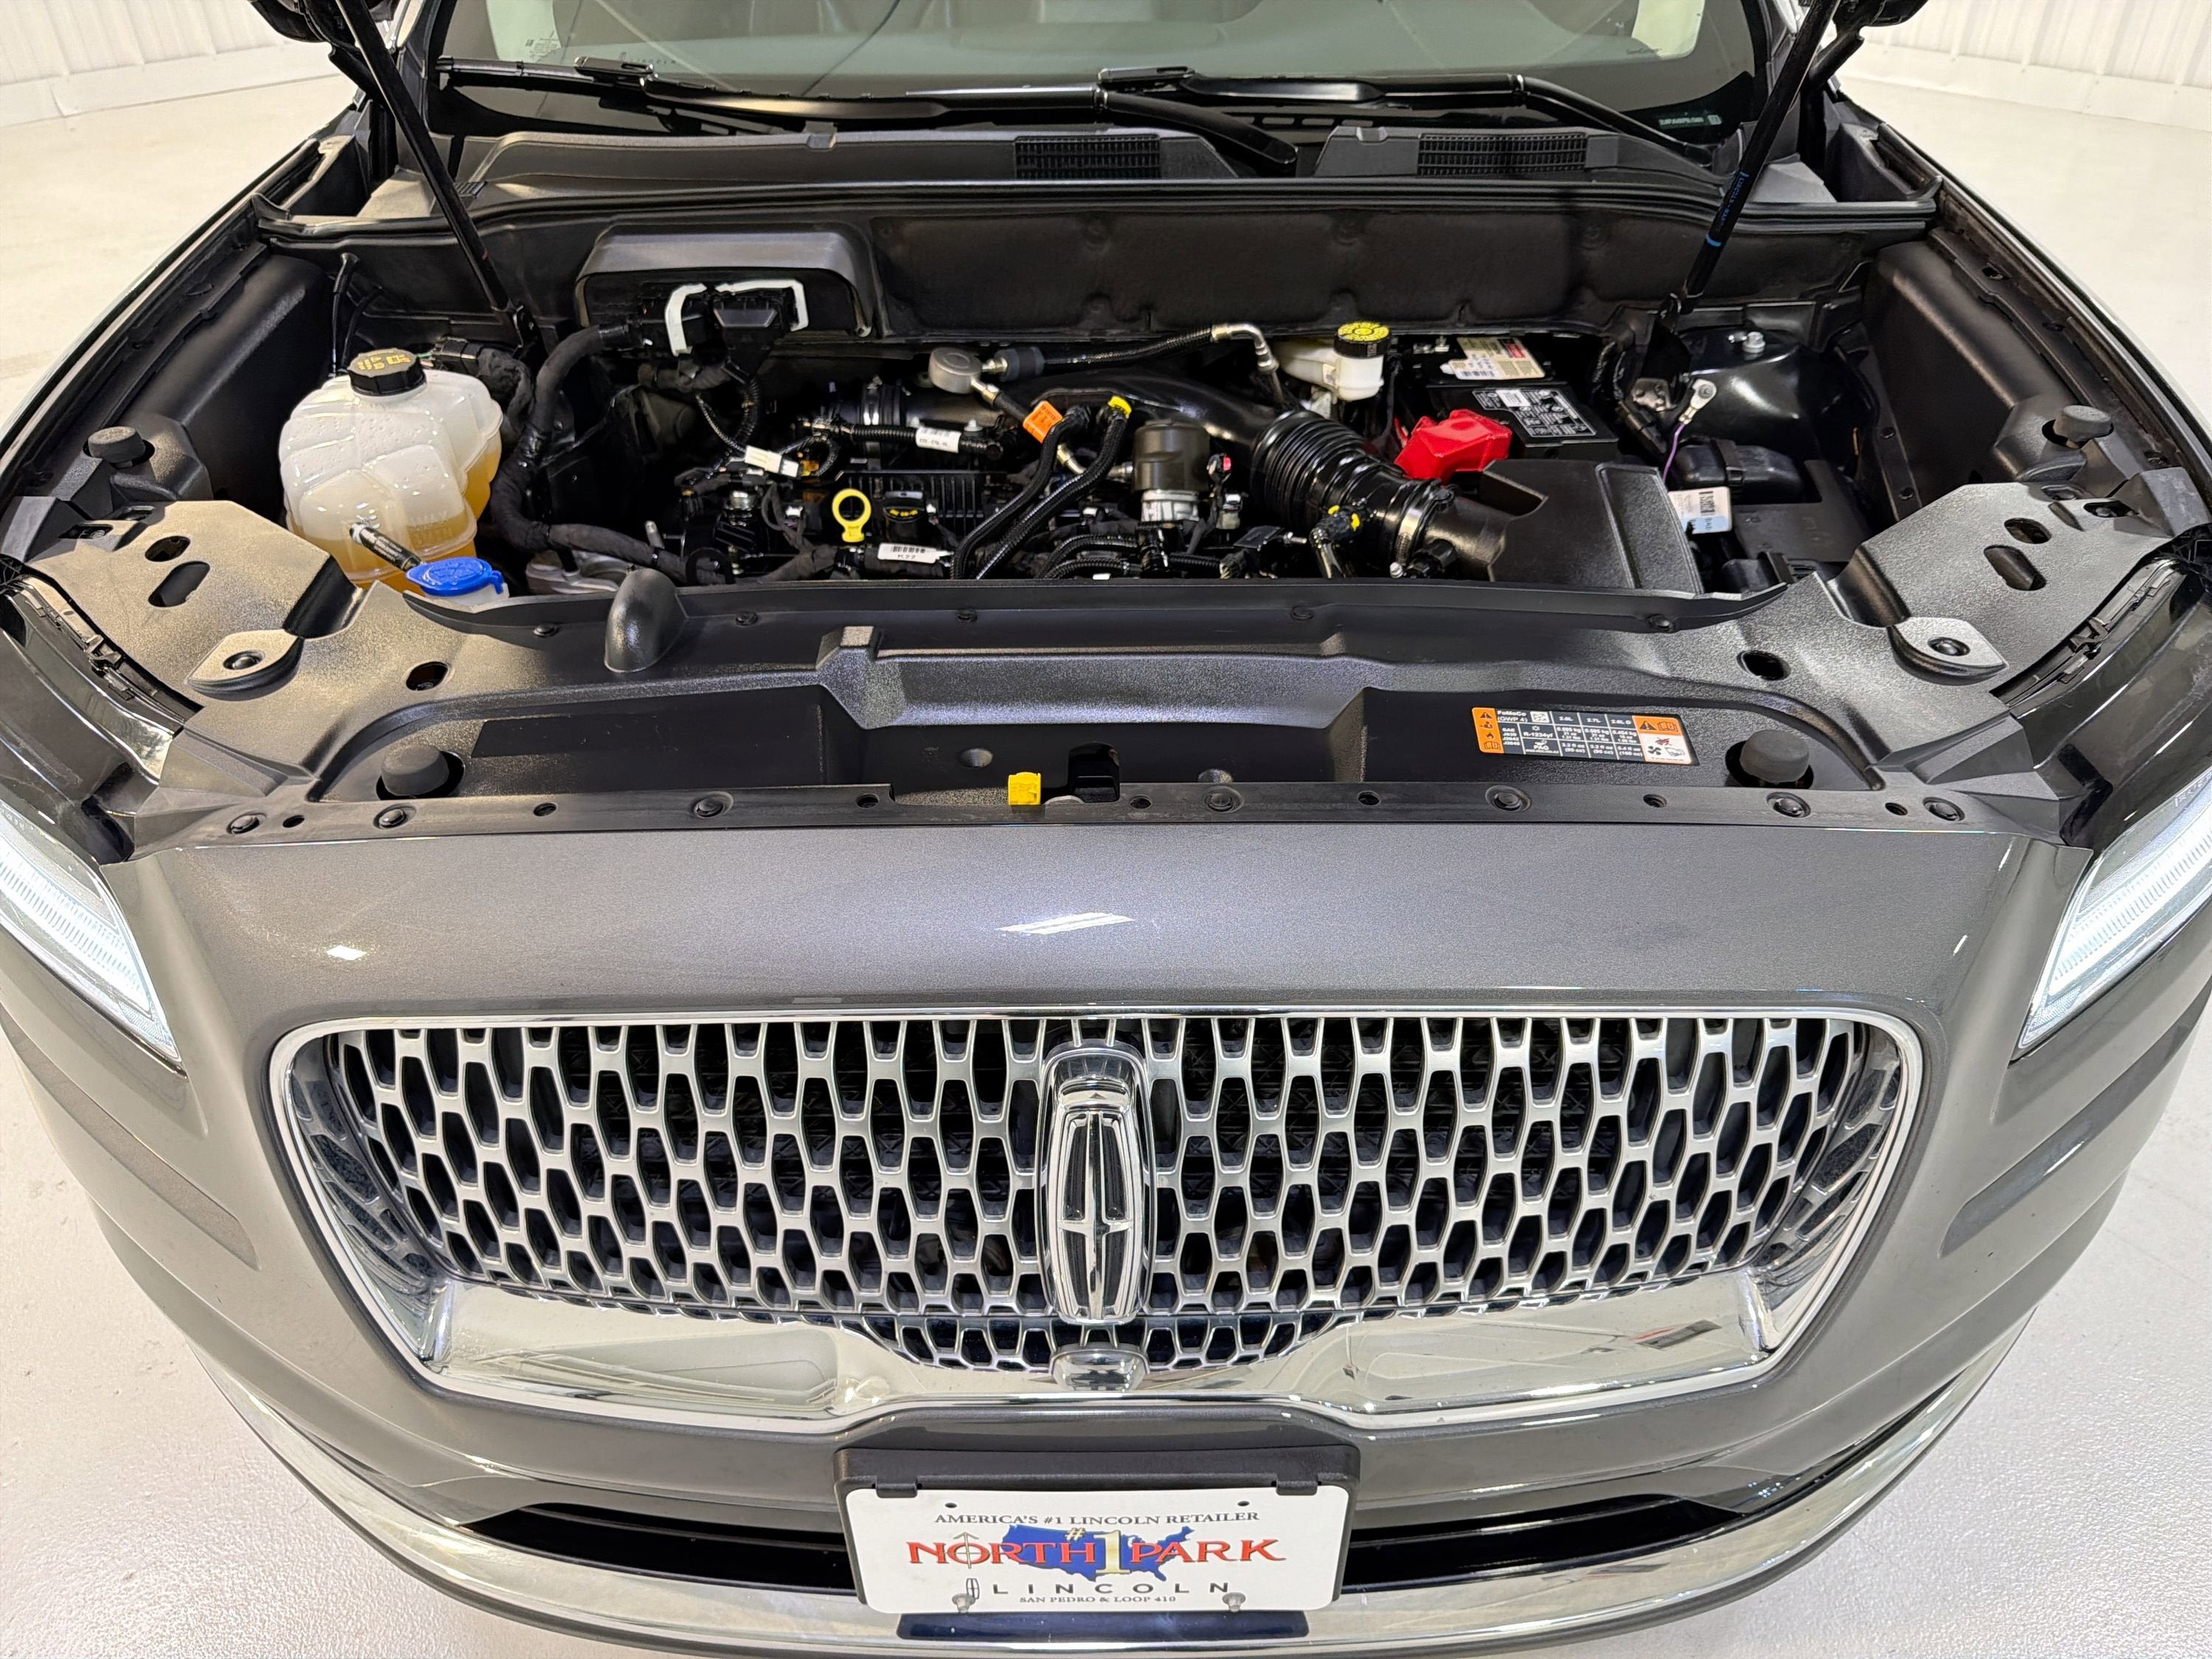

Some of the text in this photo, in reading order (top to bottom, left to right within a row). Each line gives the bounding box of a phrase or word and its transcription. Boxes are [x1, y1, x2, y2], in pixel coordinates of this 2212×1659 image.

[934, 1511, 1260, 1526] AMERICA'S #1 LINCOLN RETAILER
[906, 1539, 1287, 1565] NORTH PARK
[992, 1582, 1229, 1595] LINCOLN
